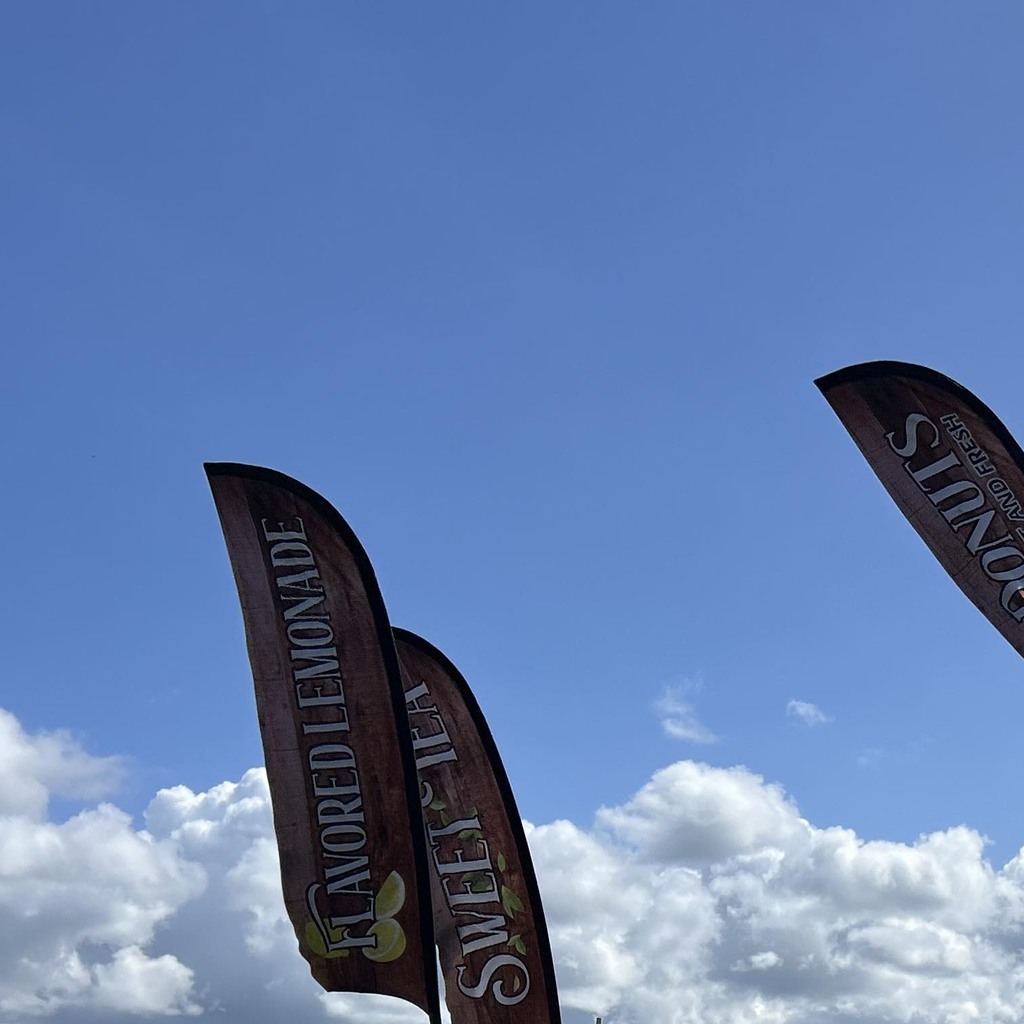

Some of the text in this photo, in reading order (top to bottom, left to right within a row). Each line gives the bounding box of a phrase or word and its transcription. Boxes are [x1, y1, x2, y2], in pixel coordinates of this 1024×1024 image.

[940, 412, 1002, 478] FRESH
[261, 516, 377, 954] FLAVORED LEMONADE
[426, 815, 530, 1006] SWEET
